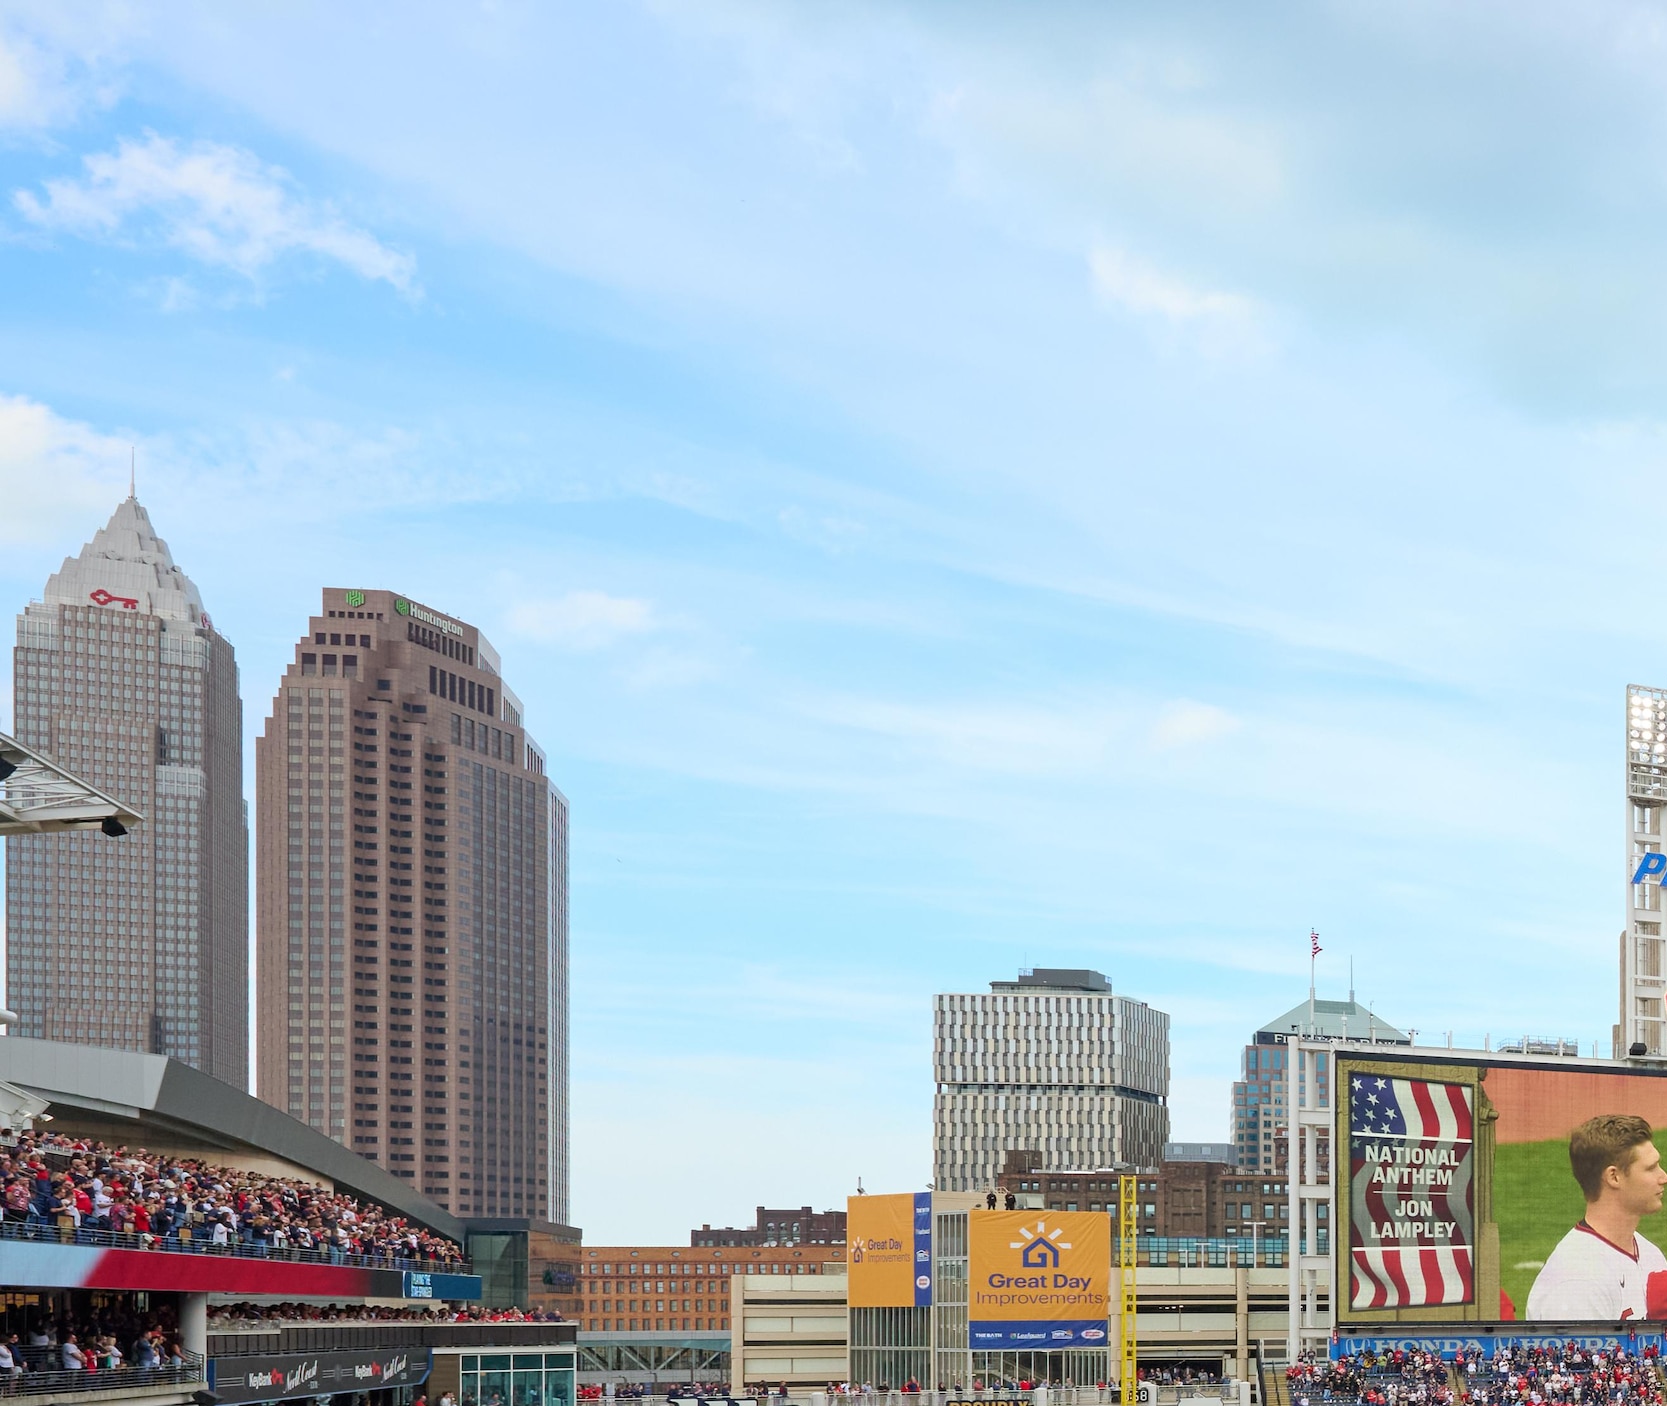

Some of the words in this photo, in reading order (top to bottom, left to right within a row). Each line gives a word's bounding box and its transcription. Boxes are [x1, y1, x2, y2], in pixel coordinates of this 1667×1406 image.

[409, 602, 463, 637] Huntington
[1365, 1145, 1460, 1167] NATIONAL
[1372, 1166, 1453, 1186] ANTHEM
[1395, 1199, 1433, 1217] JON
[1370, 1221, 1456, 1239] LAMPLEY
[867, 1239, 888, 1250] Great
[889, 1238, 903, 1251] Day
[867, 1253, 911, 1264] Improvements
[988, 1273, 1047, 1289] Great
[1053, 1273, 1092, 1291] Day
[976, 1291, 1104, 1307] Improvements
[1374, 1338, 1486, 1354] HONDA
[1519, 1336, 1620, 1353] HONDA
